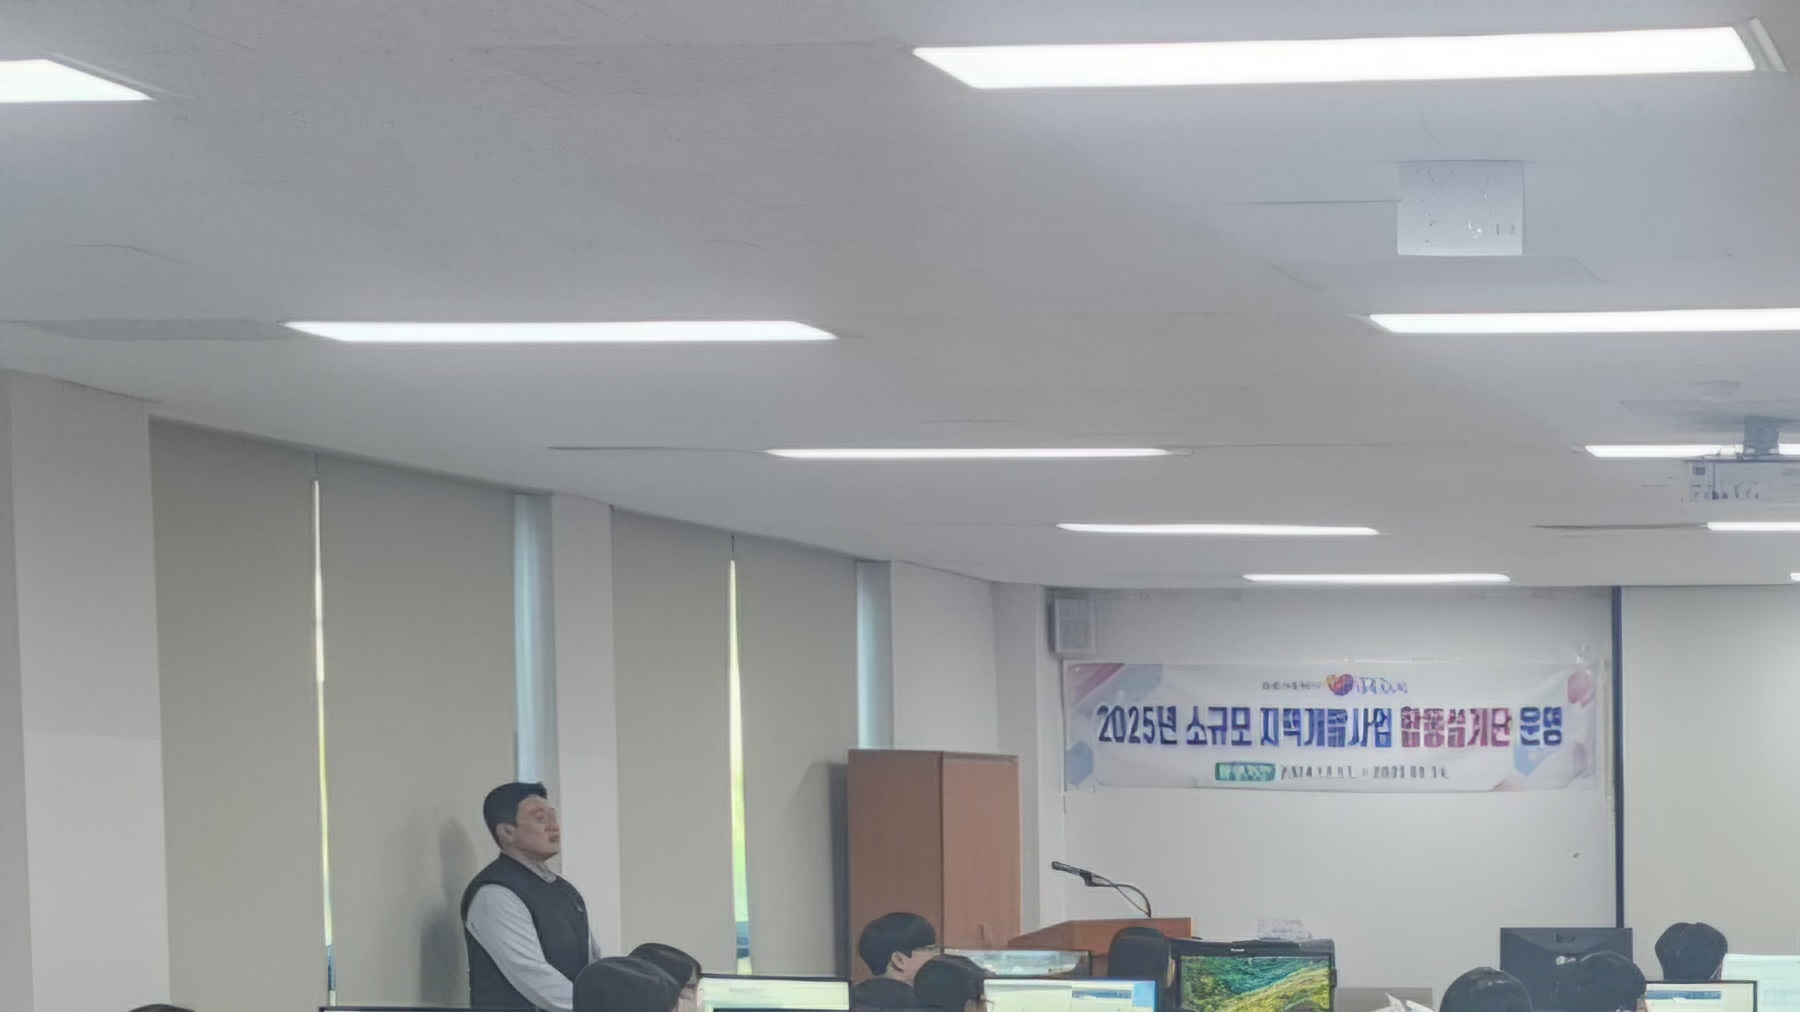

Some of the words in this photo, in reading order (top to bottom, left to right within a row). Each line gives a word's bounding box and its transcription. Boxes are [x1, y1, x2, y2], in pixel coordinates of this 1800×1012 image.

[1097, 705, 1177, 745] 2025년
[1186, 705, 1252, 746] 소규모
[1260, 707, 1392, 748] 지역개발사업
[1520, 706, 1563, 746] 운영
